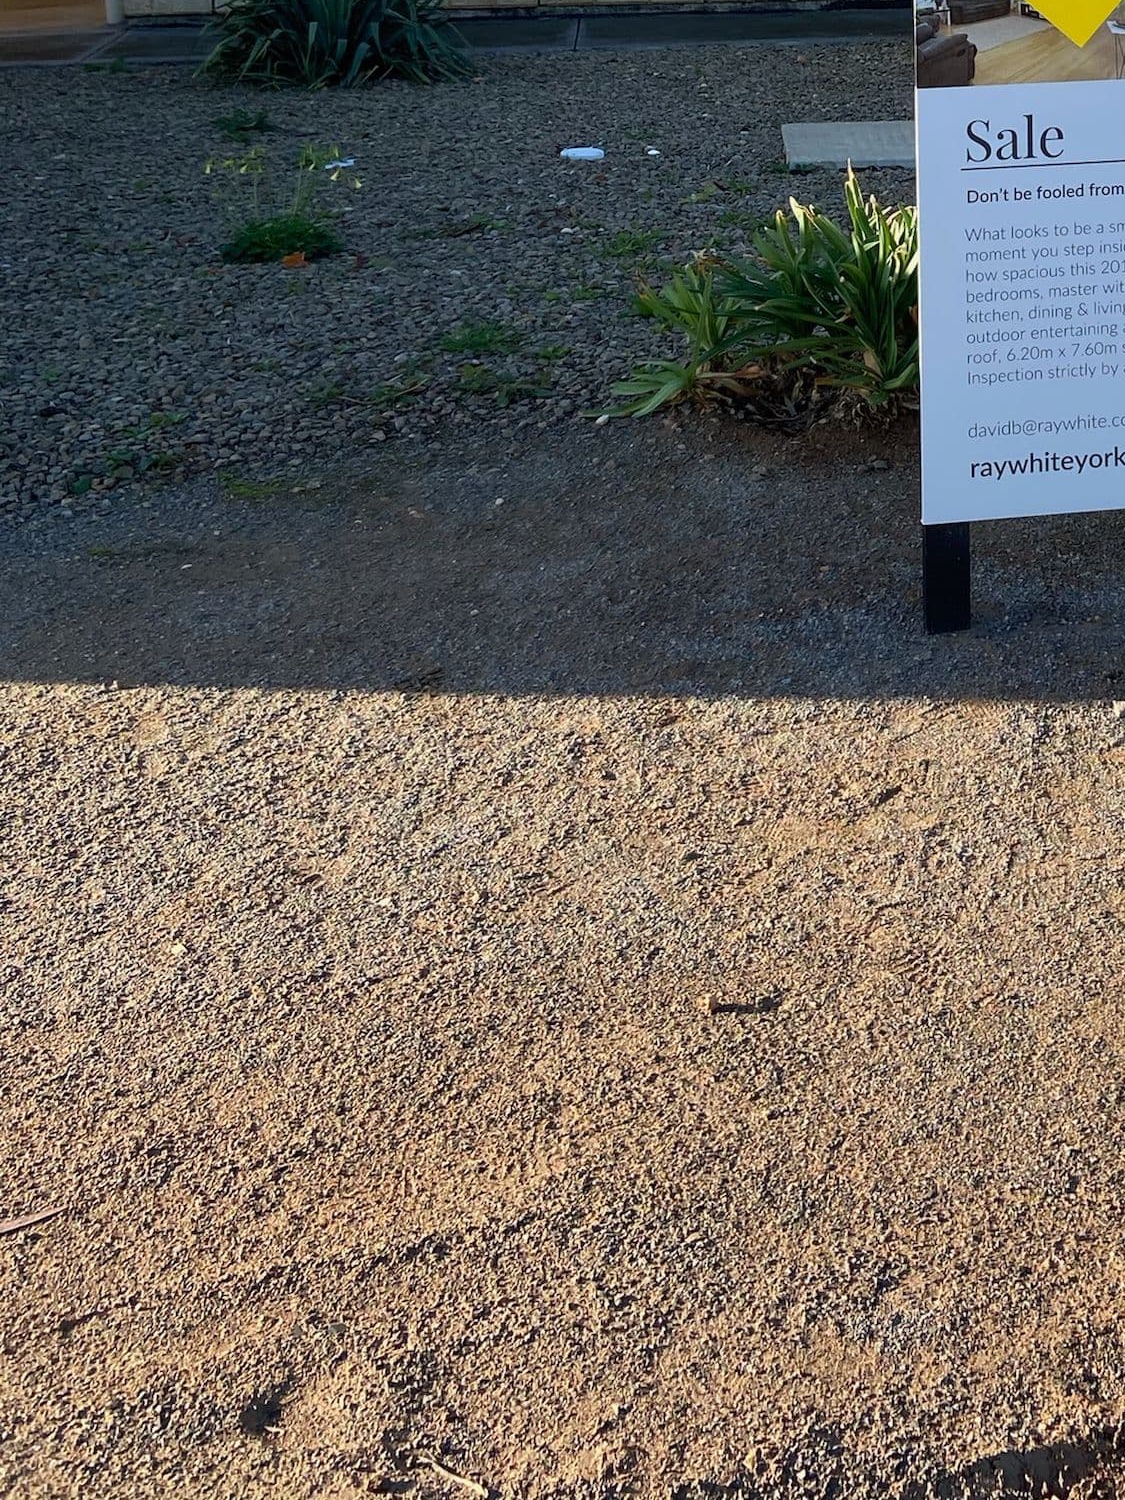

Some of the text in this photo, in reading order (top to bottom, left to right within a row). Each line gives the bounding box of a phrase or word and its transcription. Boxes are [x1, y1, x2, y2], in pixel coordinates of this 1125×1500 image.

[966, 113, 1064, 162] Sale
[966, 187, 1009, 204] Don't
[1013, 186, 1032, 201] be
[1036, 182, 1084, 199] fooled
[1088, 182, 1124, 196] from
[964, 227, 1006, 242] What
[1010, 223, 1049, 239] looks
[1053, 223, 1069, 237] to
[1073, 221, 1092, 235] be
[1095, 223, 1104, 234] a
[965, 246, 1027, 263] moment
[1030, 246, 1058, 261] you
[1063, 243, 1094, 257] step
[965, 268, 998, 283] how
[1001, 264, 1065, 283] spacious
[1069, 261, 1096, 276] this
[965, 287, 1043, 304] bedrooms,
[1048, 283, 1098, 298] master
[965, 308, 1023, 323] kitchen,
[1027, 303, 1072, 320] dining
[1076, 301, 1088, 316] &
[965, 327, 1026, 344] outdoor
[1030, 322, 1118, 340] entertaining
[966, 348, 1001, 364] roof,
[1006, 345, 1053, 362] 6.20m
[1057, 347, 1066, 358] x
[1071, 341, 1117, 357] 7.60m
[967, 367, 1043, 386] Inspection
[1047, 362, 1096, 379] strictly
[1100, 361, 1119, 377] by
